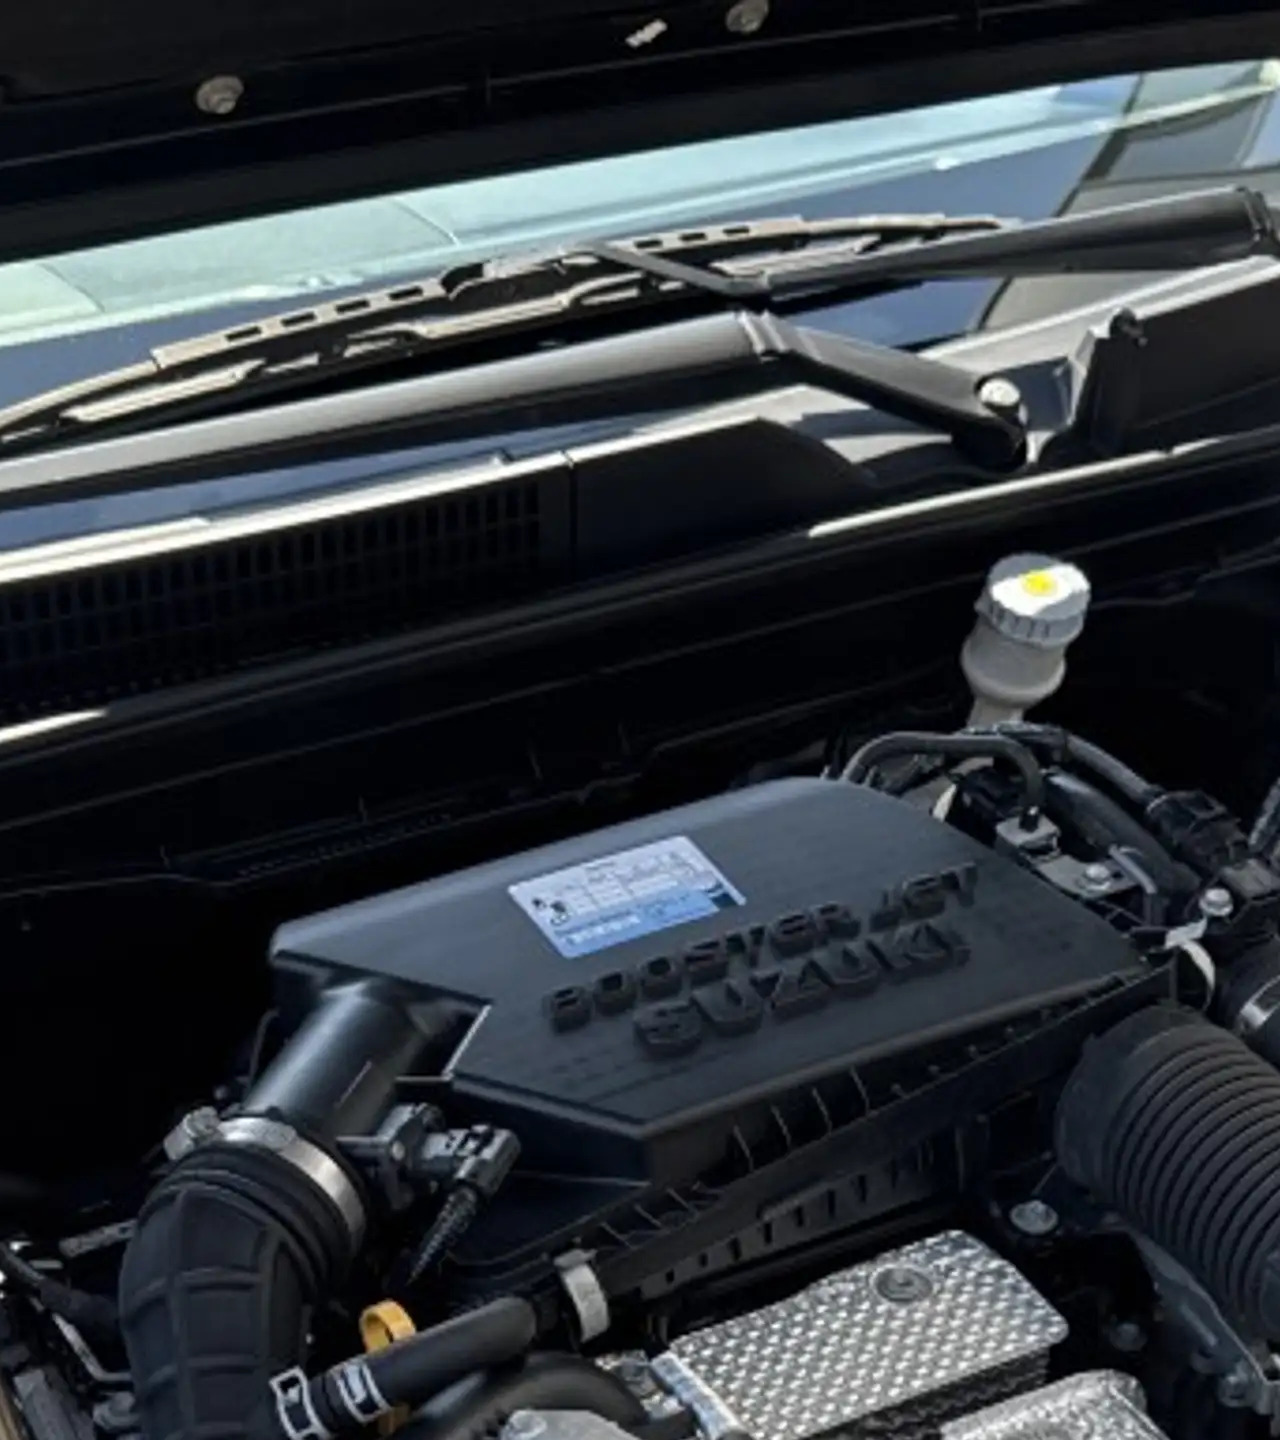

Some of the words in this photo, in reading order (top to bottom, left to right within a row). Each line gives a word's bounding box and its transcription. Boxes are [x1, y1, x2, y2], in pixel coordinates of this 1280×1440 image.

[547, 903, 860, 1033] BOOSTER
[870, 862, 979, 929] JET
[634, 917, 971, 1058] SUZUKI
